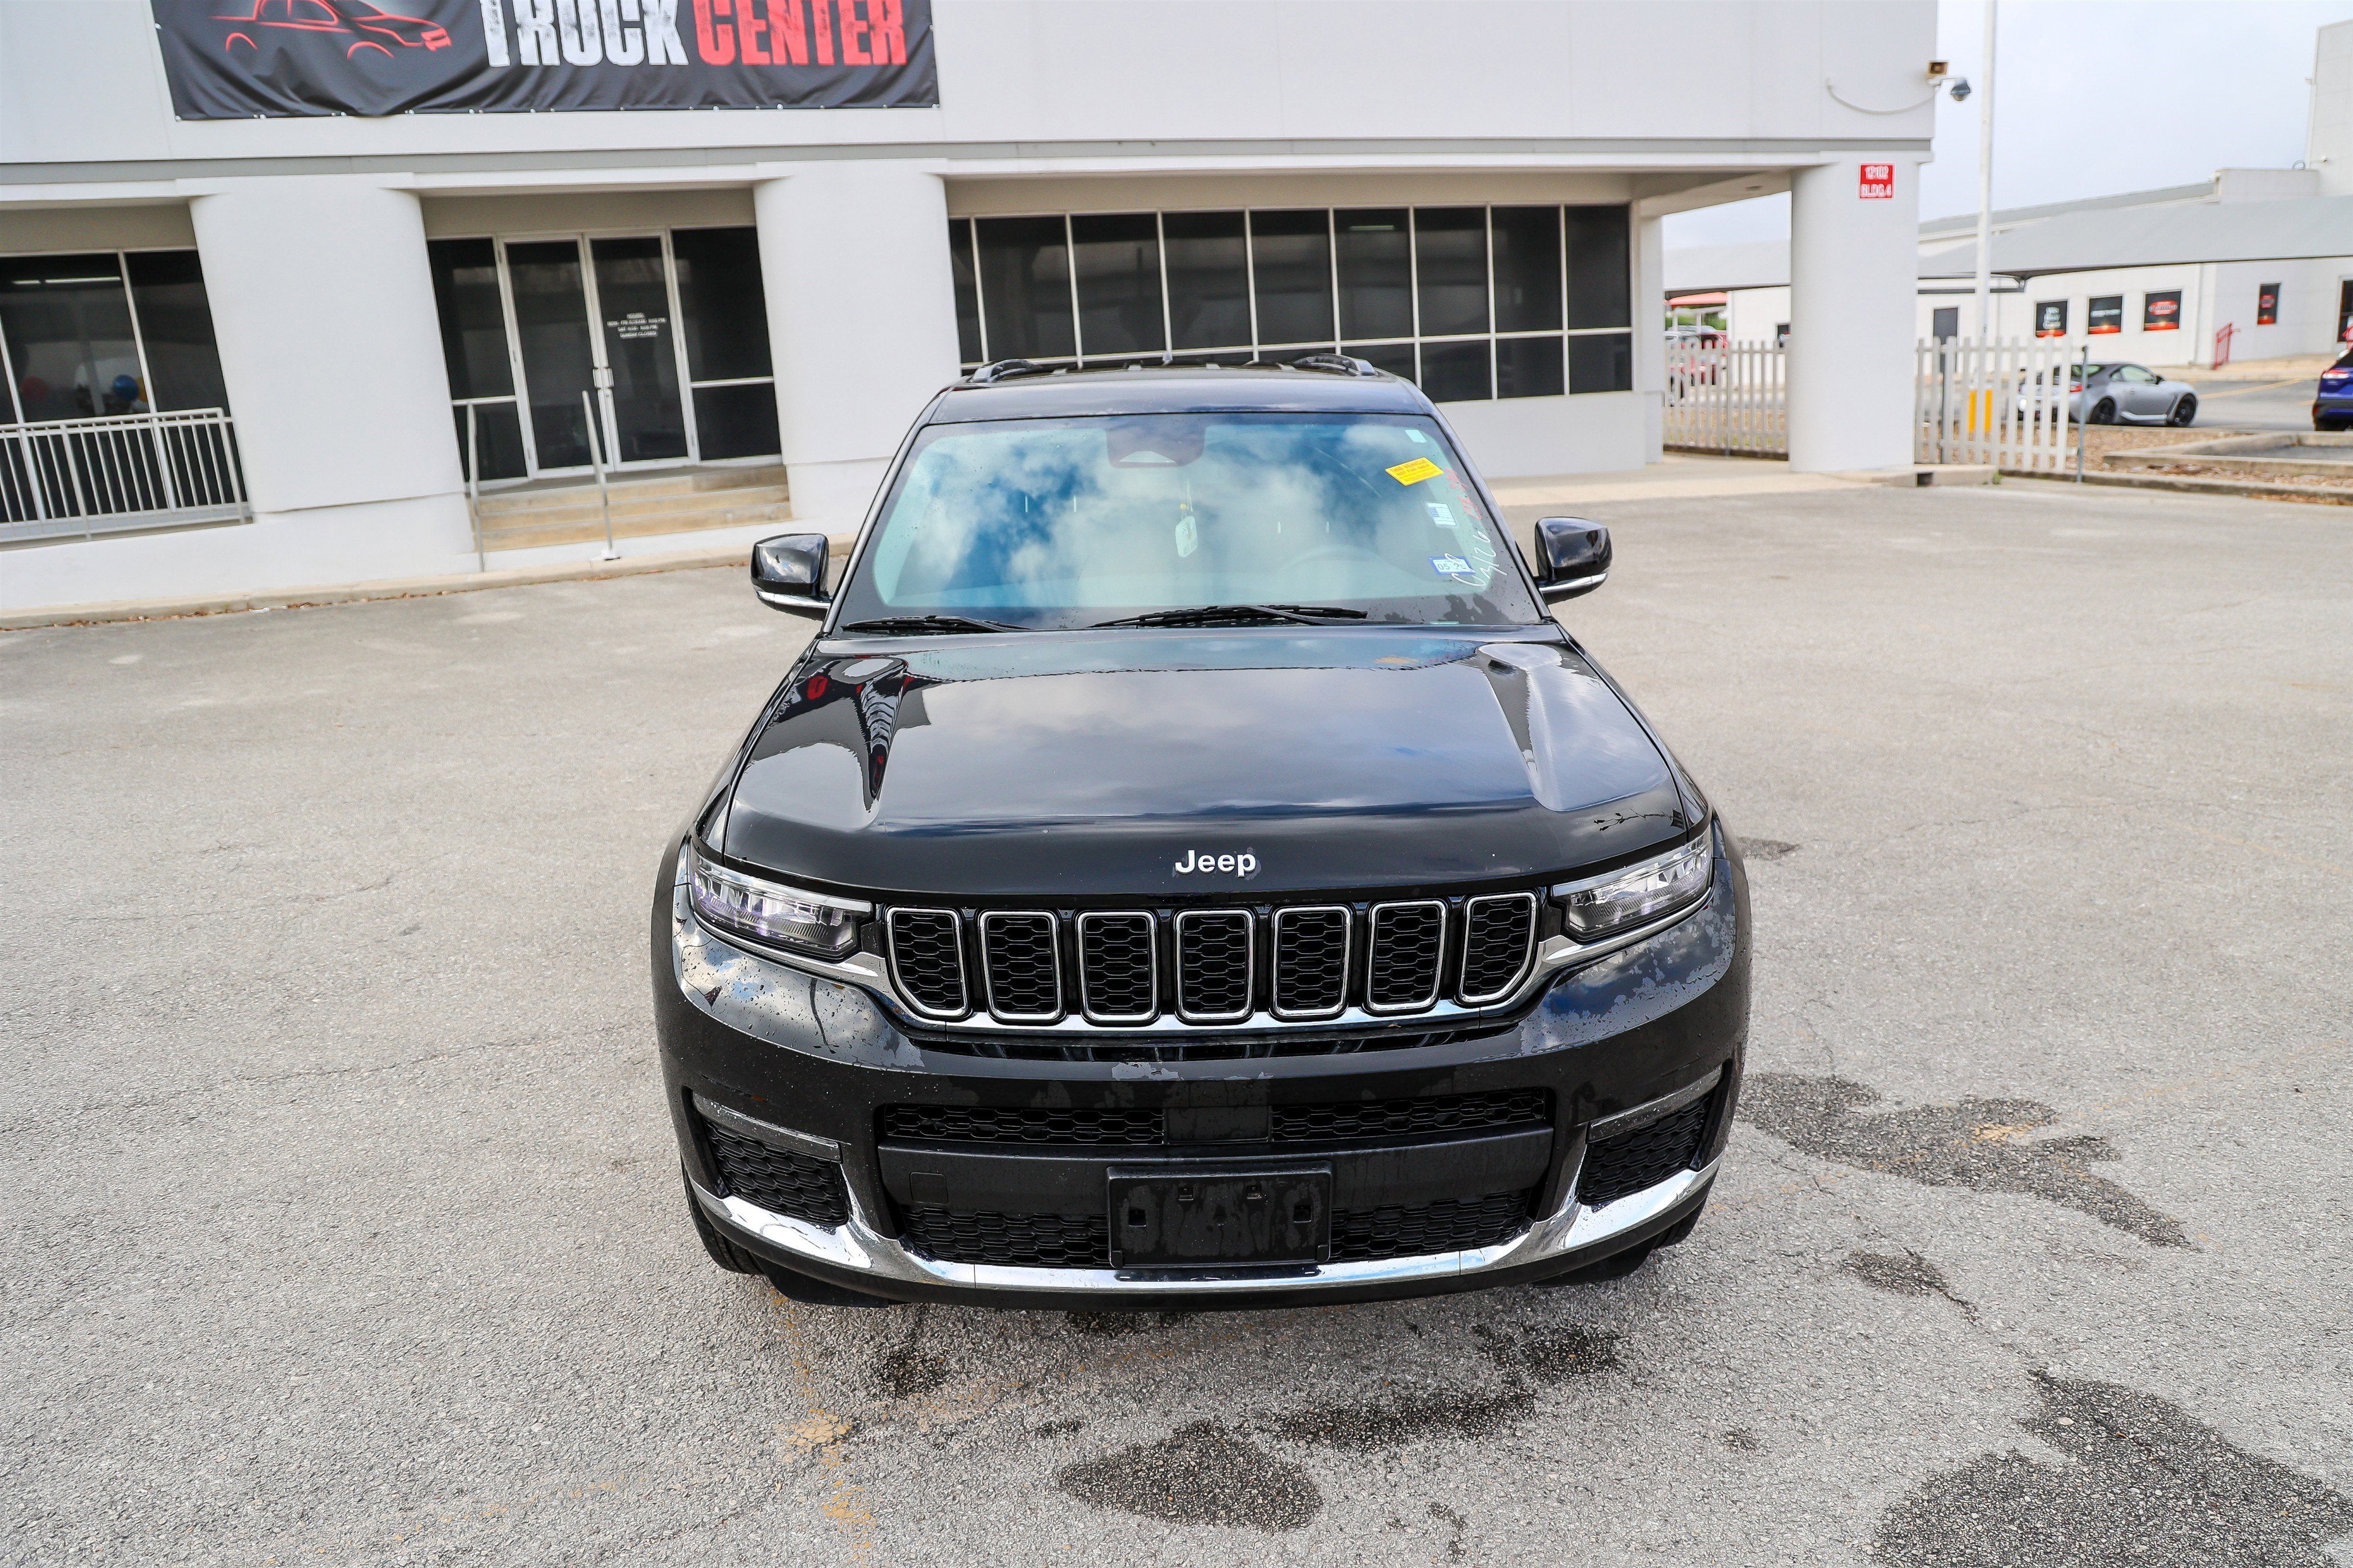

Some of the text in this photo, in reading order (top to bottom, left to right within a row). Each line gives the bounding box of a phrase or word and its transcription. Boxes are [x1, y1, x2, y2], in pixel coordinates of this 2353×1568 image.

[692, 0, 907, 66] CENTER
[1405, 459, 1427, 470] VEHICLE
[1175, 849, 1256, 878] Jeep
